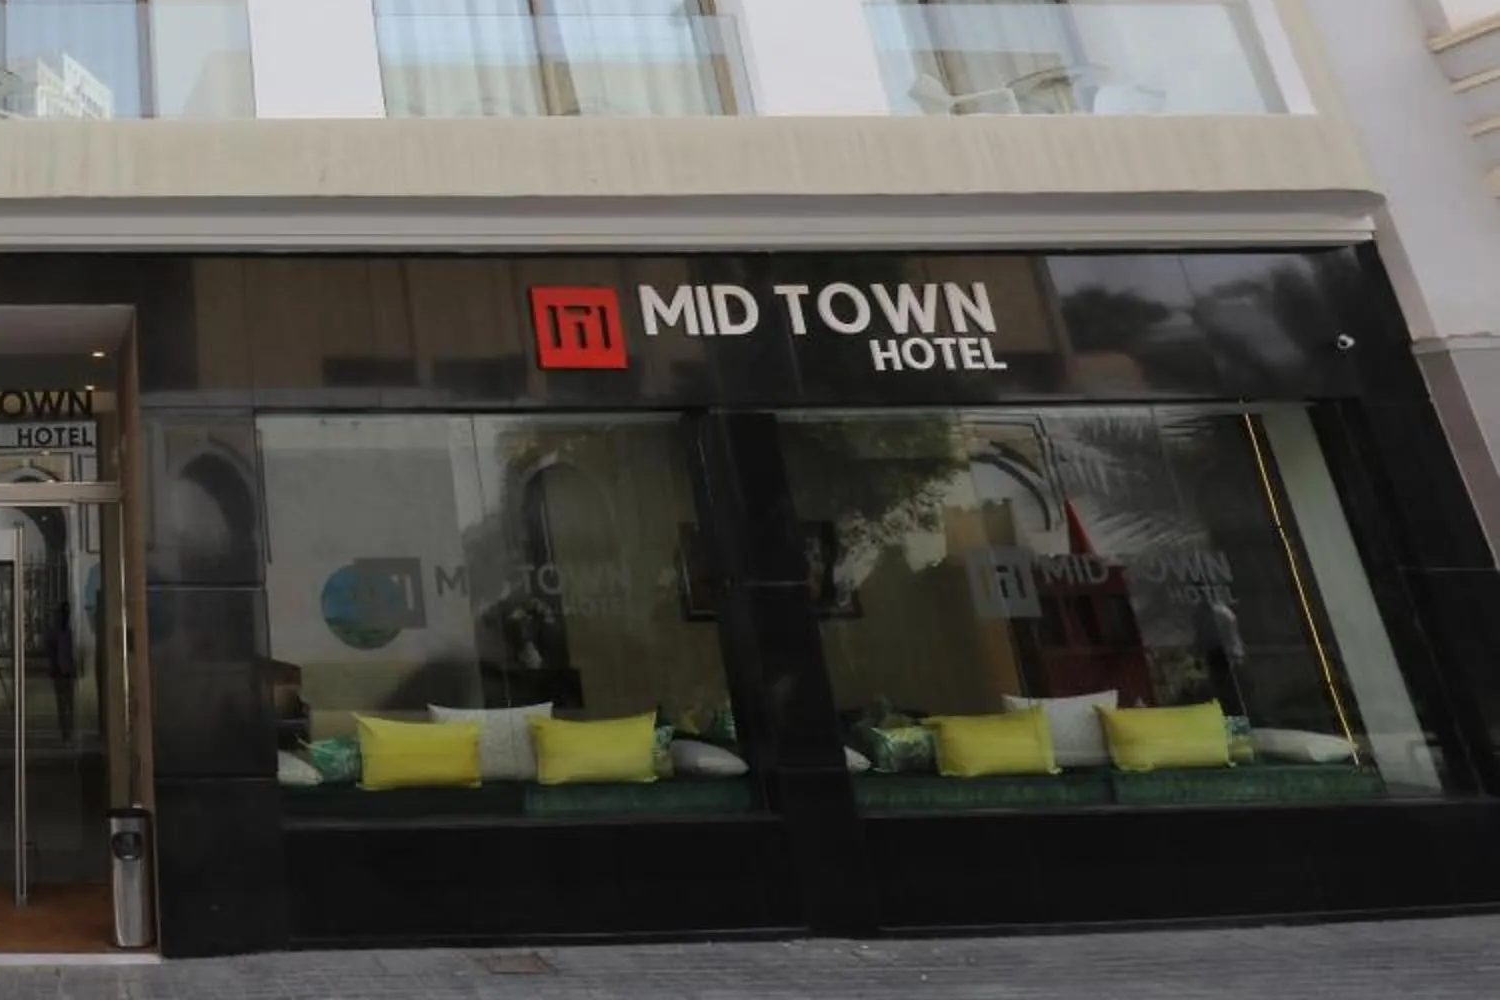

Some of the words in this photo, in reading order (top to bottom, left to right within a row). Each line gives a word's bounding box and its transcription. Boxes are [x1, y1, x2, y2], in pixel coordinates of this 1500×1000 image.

[637, 284, 760, 336] MID
[773, 280, 998, 336] TOWN
[869, 337, 1008, 372] HOTEL
[17, 427, 94, 447] HOTEL
[1124, 550, 1235, 584] OWN
